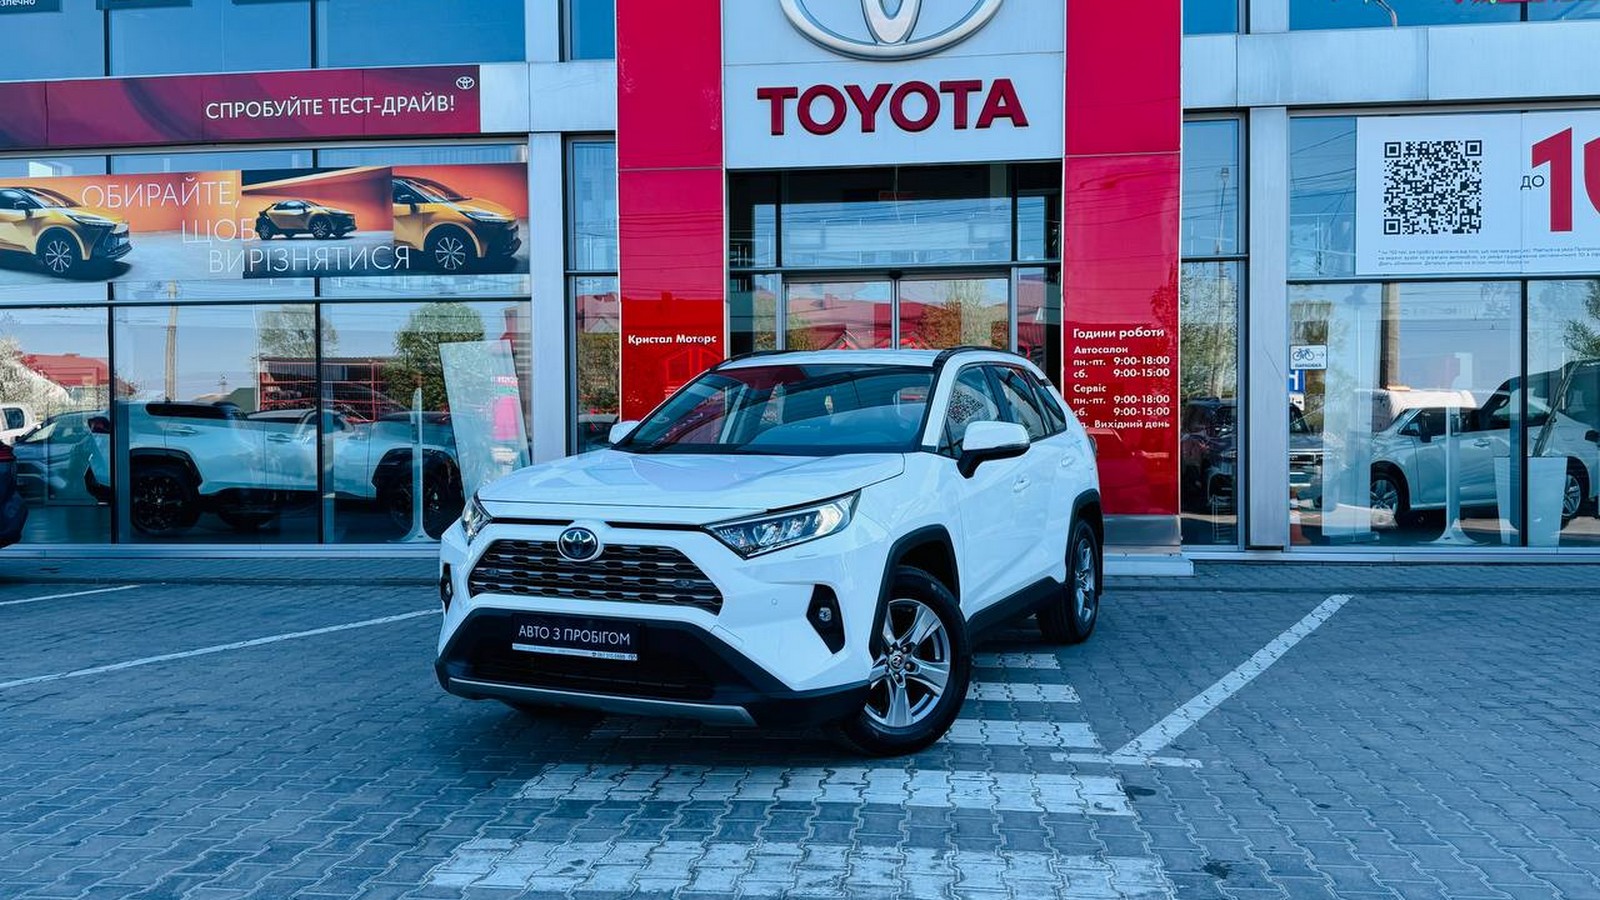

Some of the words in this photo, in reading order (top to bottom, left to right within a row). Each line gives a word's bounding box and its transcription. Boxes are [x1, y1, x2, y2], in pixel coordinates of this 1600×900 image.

[205, 96, 324, 120] СПРОБУЙТЕ
[328, 92, 456, 116] ТЕСТ-ДРАЙВ!
[757, 78, 1029, 136] TOYOTA
[81, 175, 240, 210] ОБИРАЙТЕ,
[180, 218, 257, 246] ЩОБ
[209, 245, 411, 274] ВИРІЗНЯТИСЯ
[1073, 328, 1116, 340] Години
[1119, 326, 1165, 340] роботи
[628, 334, 673, 346] Кристал
[676, 334, 717, 345] Моторс
[1073, 346, 1128, 354] Автосалон
[1113, 356, 1170, 366] 9:00-18:00
[1073, 369, 1088, 379] сб.
[1113, 368, 1170, 378] 9:00-15:00
[1073, 384, 1107, 394] Сервіс
[1113, 395, 1170, 405] 9:00-18:00
[1113, 407, 1170, 417] 9:00-15:00
[1094, 419, 1143, 429] Вихідний
[518, 625, 550, 640] АВТО
[564, 627, 631, 646] ПРОБІГОМ
